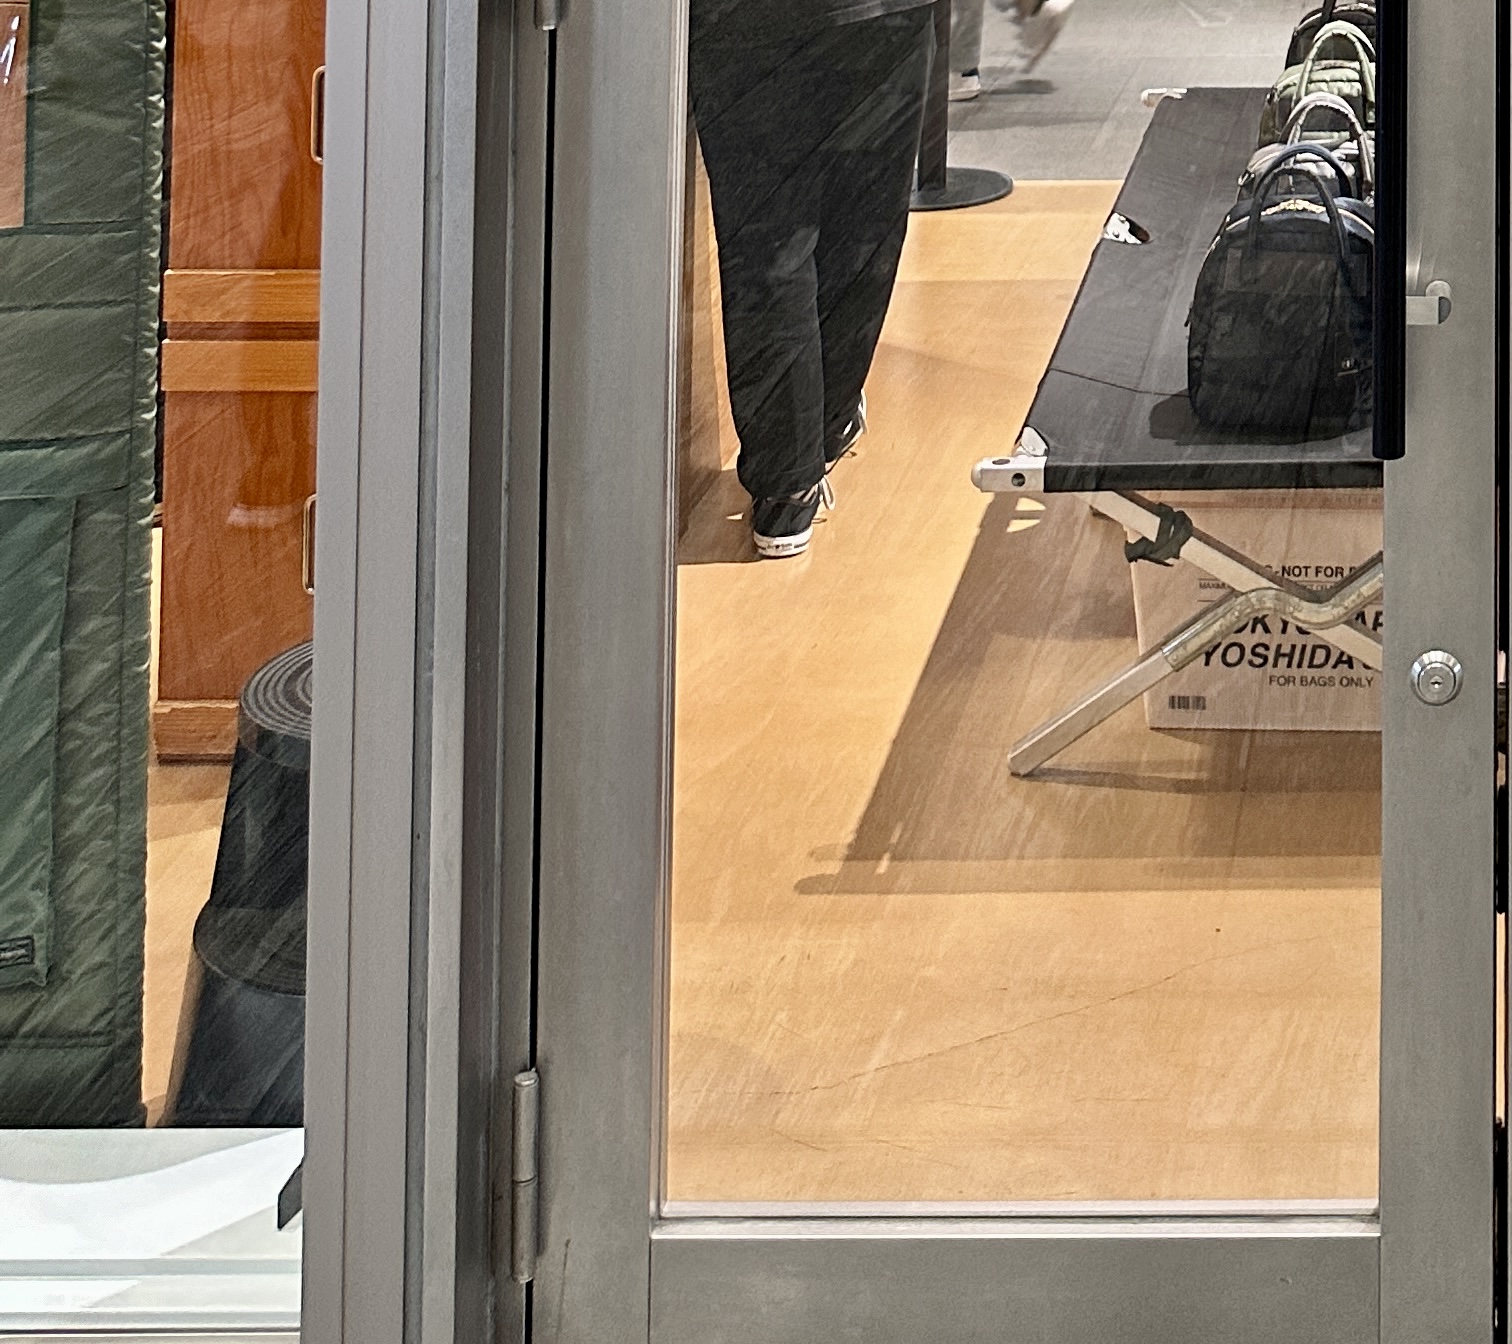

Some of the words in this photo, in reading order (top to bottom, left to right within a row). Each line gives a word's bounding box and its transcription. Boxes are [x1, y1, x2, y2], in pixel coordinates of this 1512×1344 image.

[1314, 564, 1344, 579] FOR
[1203, 641, 1355, 670] YOSHIDA
[1269, 675, 1297, 687] FOR
[1299, 675, 1336, 687] BAGS
[1340, 676, 1374, 689] ONLY
